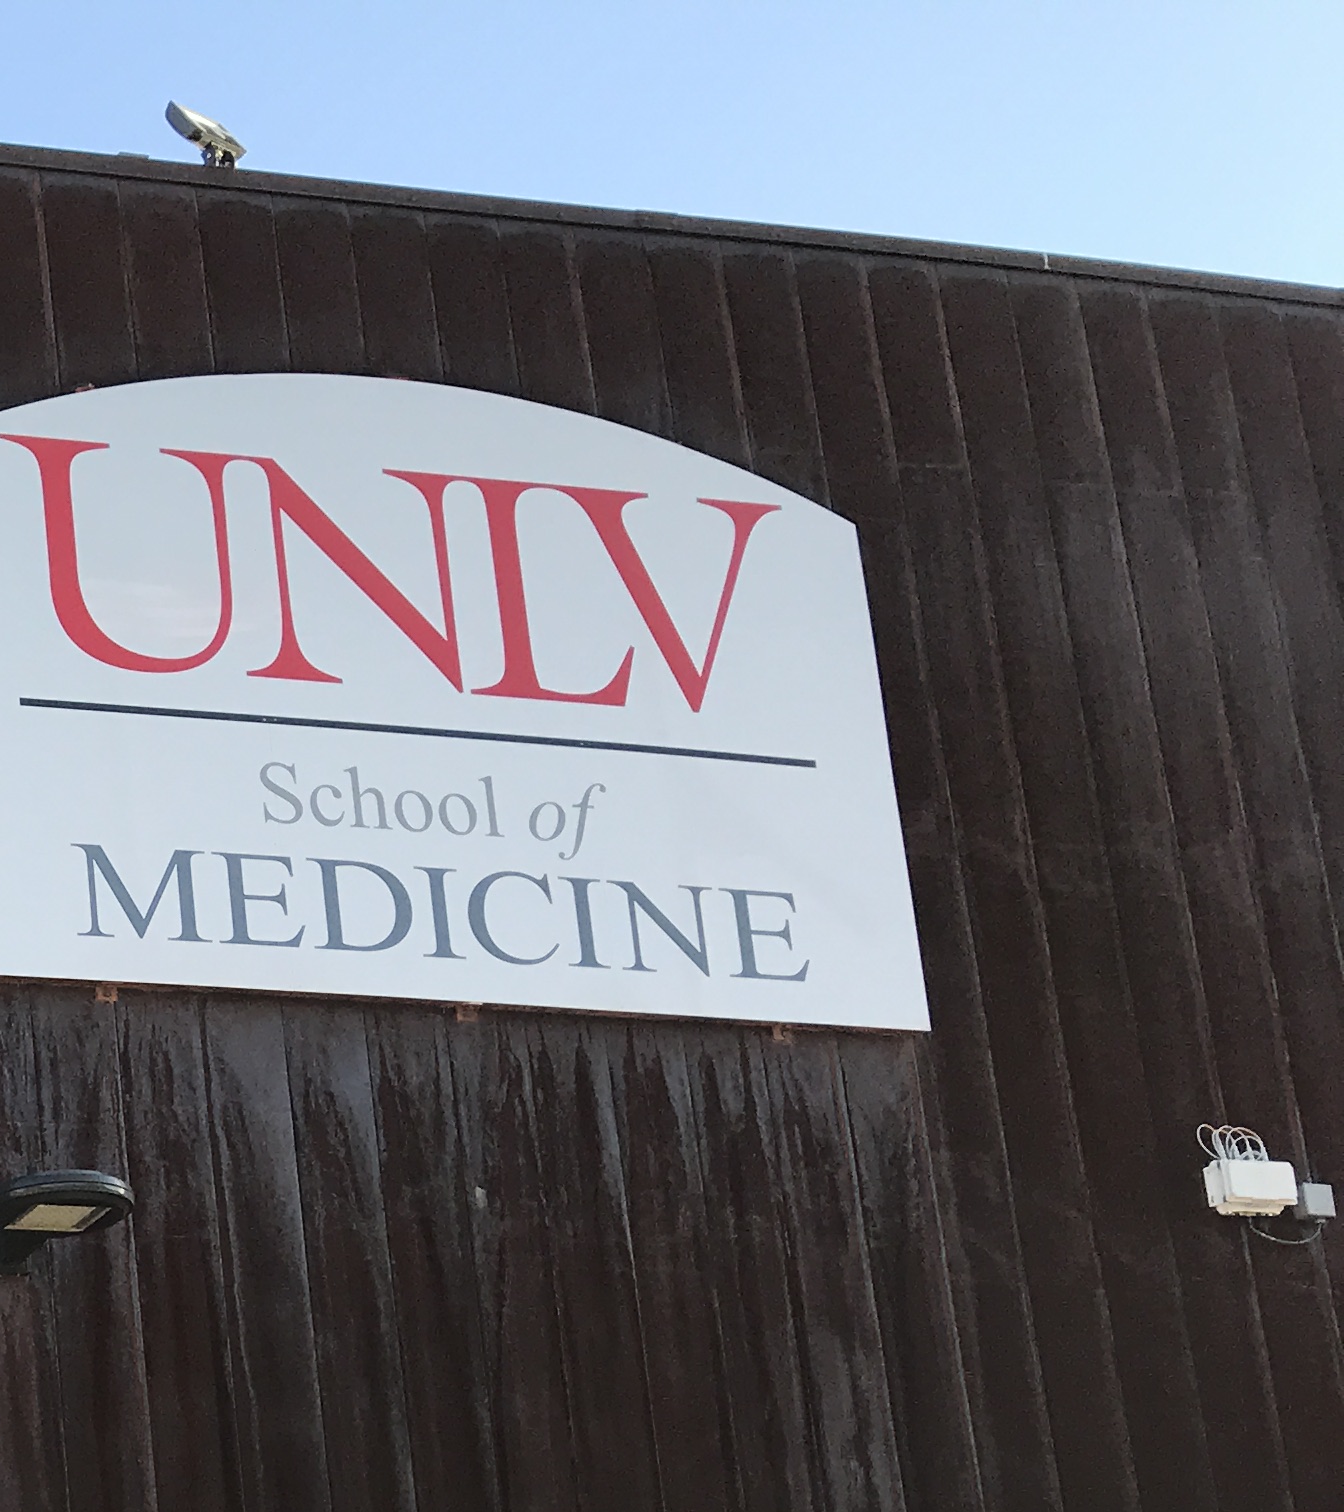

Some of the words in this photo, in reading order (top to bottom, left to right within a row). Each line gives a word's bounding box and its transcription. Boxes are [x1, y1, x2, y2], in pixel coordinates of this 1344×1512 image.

[0, 434, 780, 713] UNLV
[261, 762, 502, 838] School
[529, 784, 607, 860] of
[71, 843, 811, 983] MEDICINE
